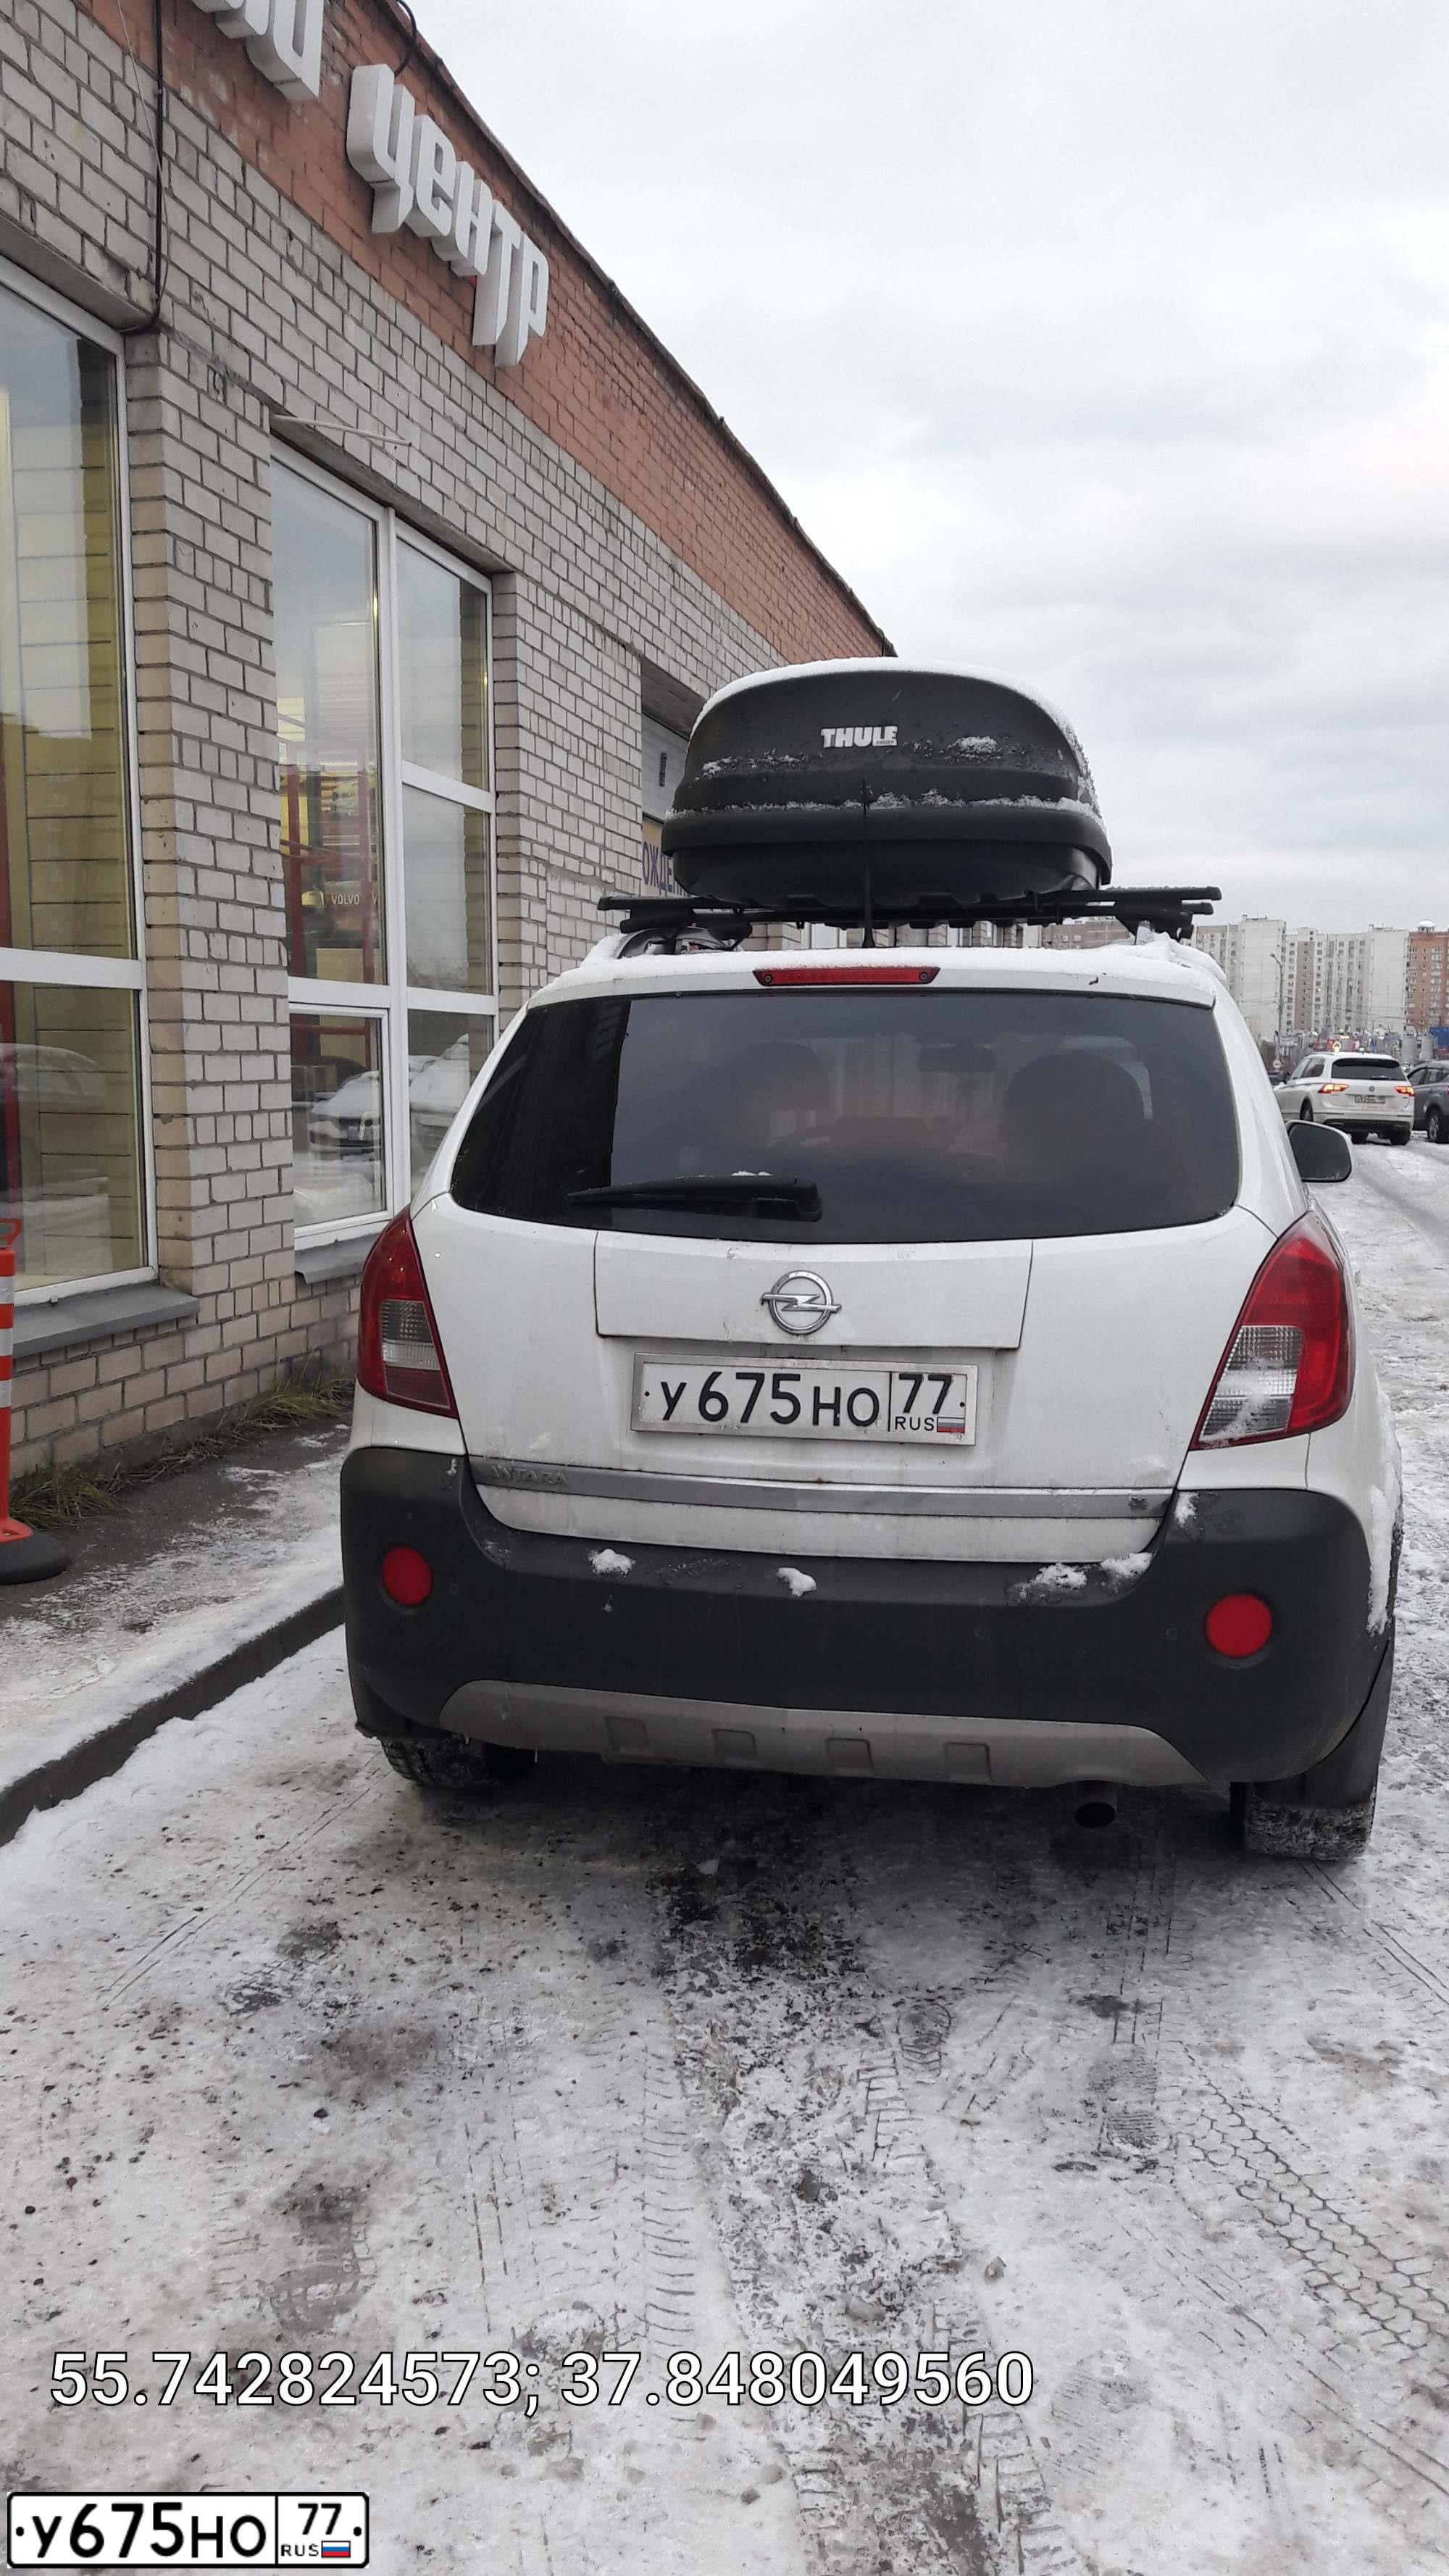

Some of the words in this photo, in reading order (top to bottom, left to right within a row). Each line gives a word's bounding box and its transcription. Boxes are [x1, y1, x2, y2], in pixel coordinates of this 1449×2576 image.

[821, 726, 898, 748] THULE
[331, 893, 360, 905] VOLVO
[898, 1374, 952, 1414] 77
[895, 1417, 935, 1432] RUS
